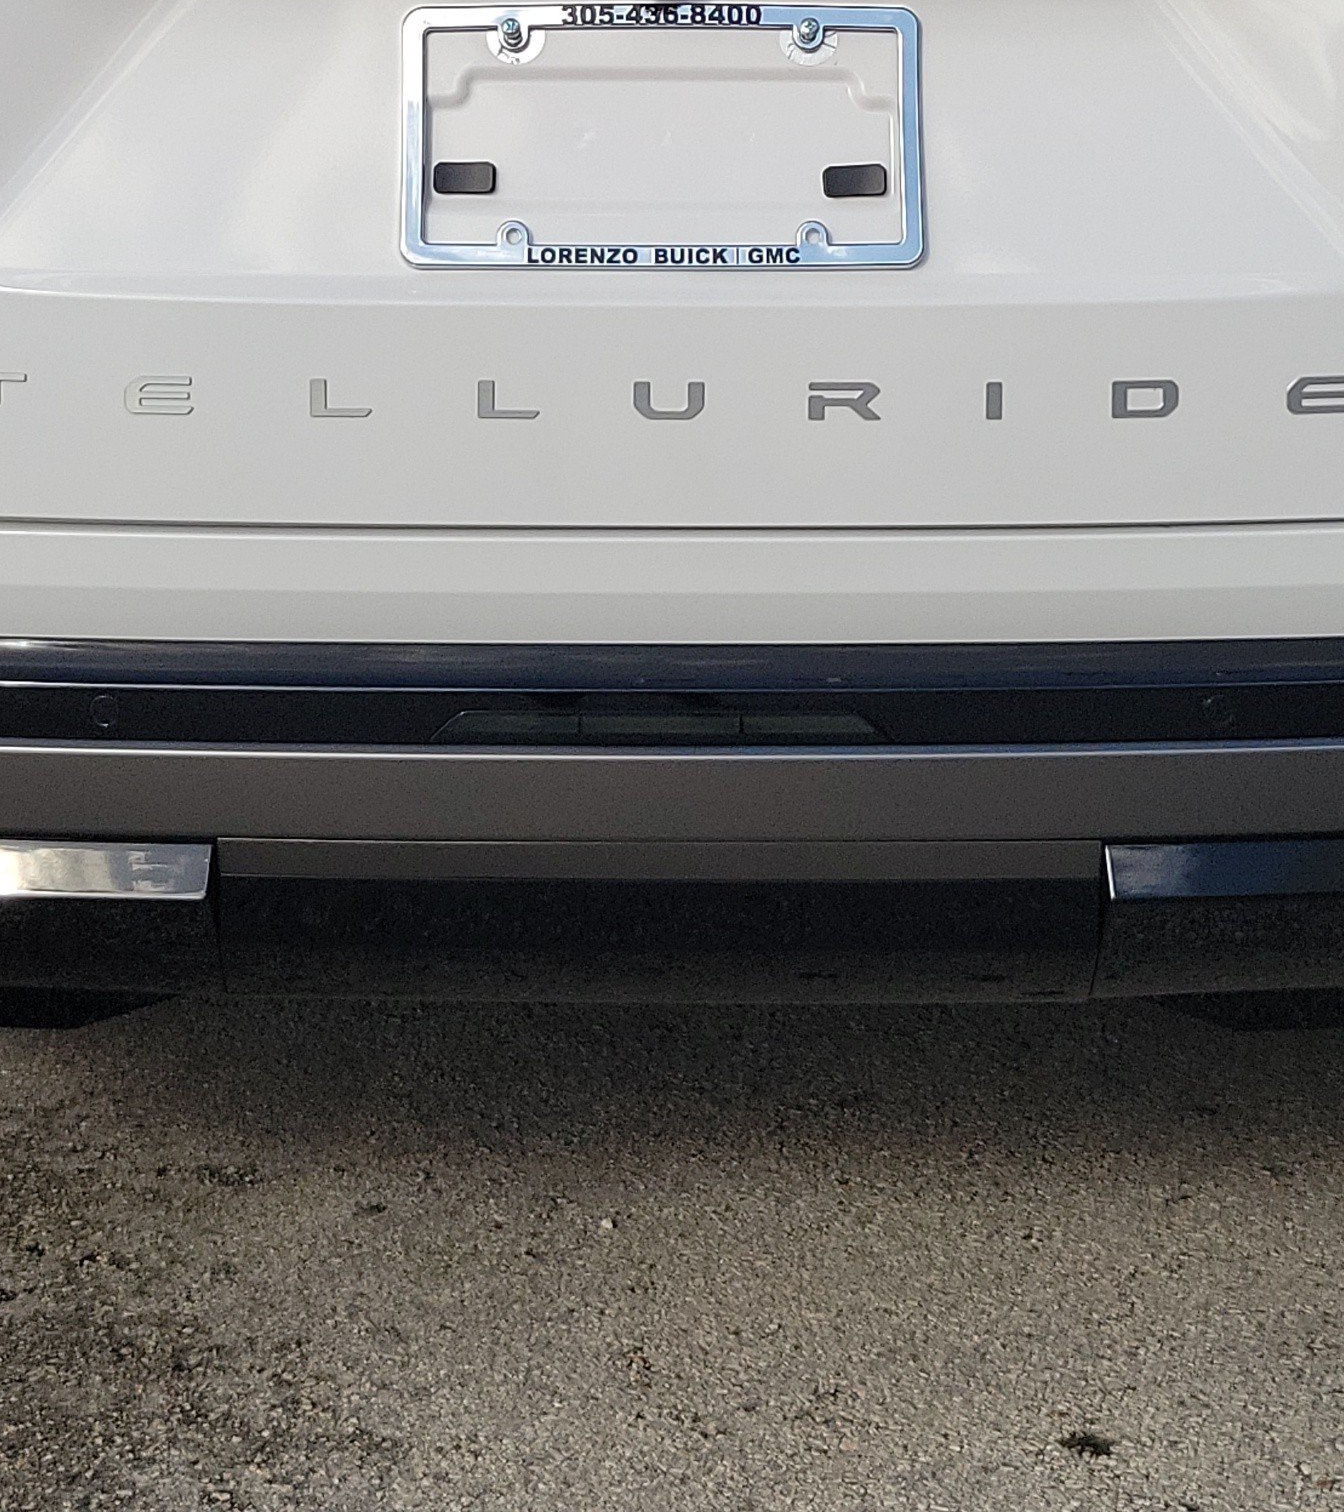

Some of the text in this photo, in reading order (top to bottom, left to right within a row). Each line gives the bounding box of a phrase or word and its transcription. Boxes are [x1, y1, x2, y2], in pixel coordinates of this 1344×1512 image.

[561, 4, 762, 26] 305-436-8400
[526, 246, 802, 265] LORENZO BUICK GMC
